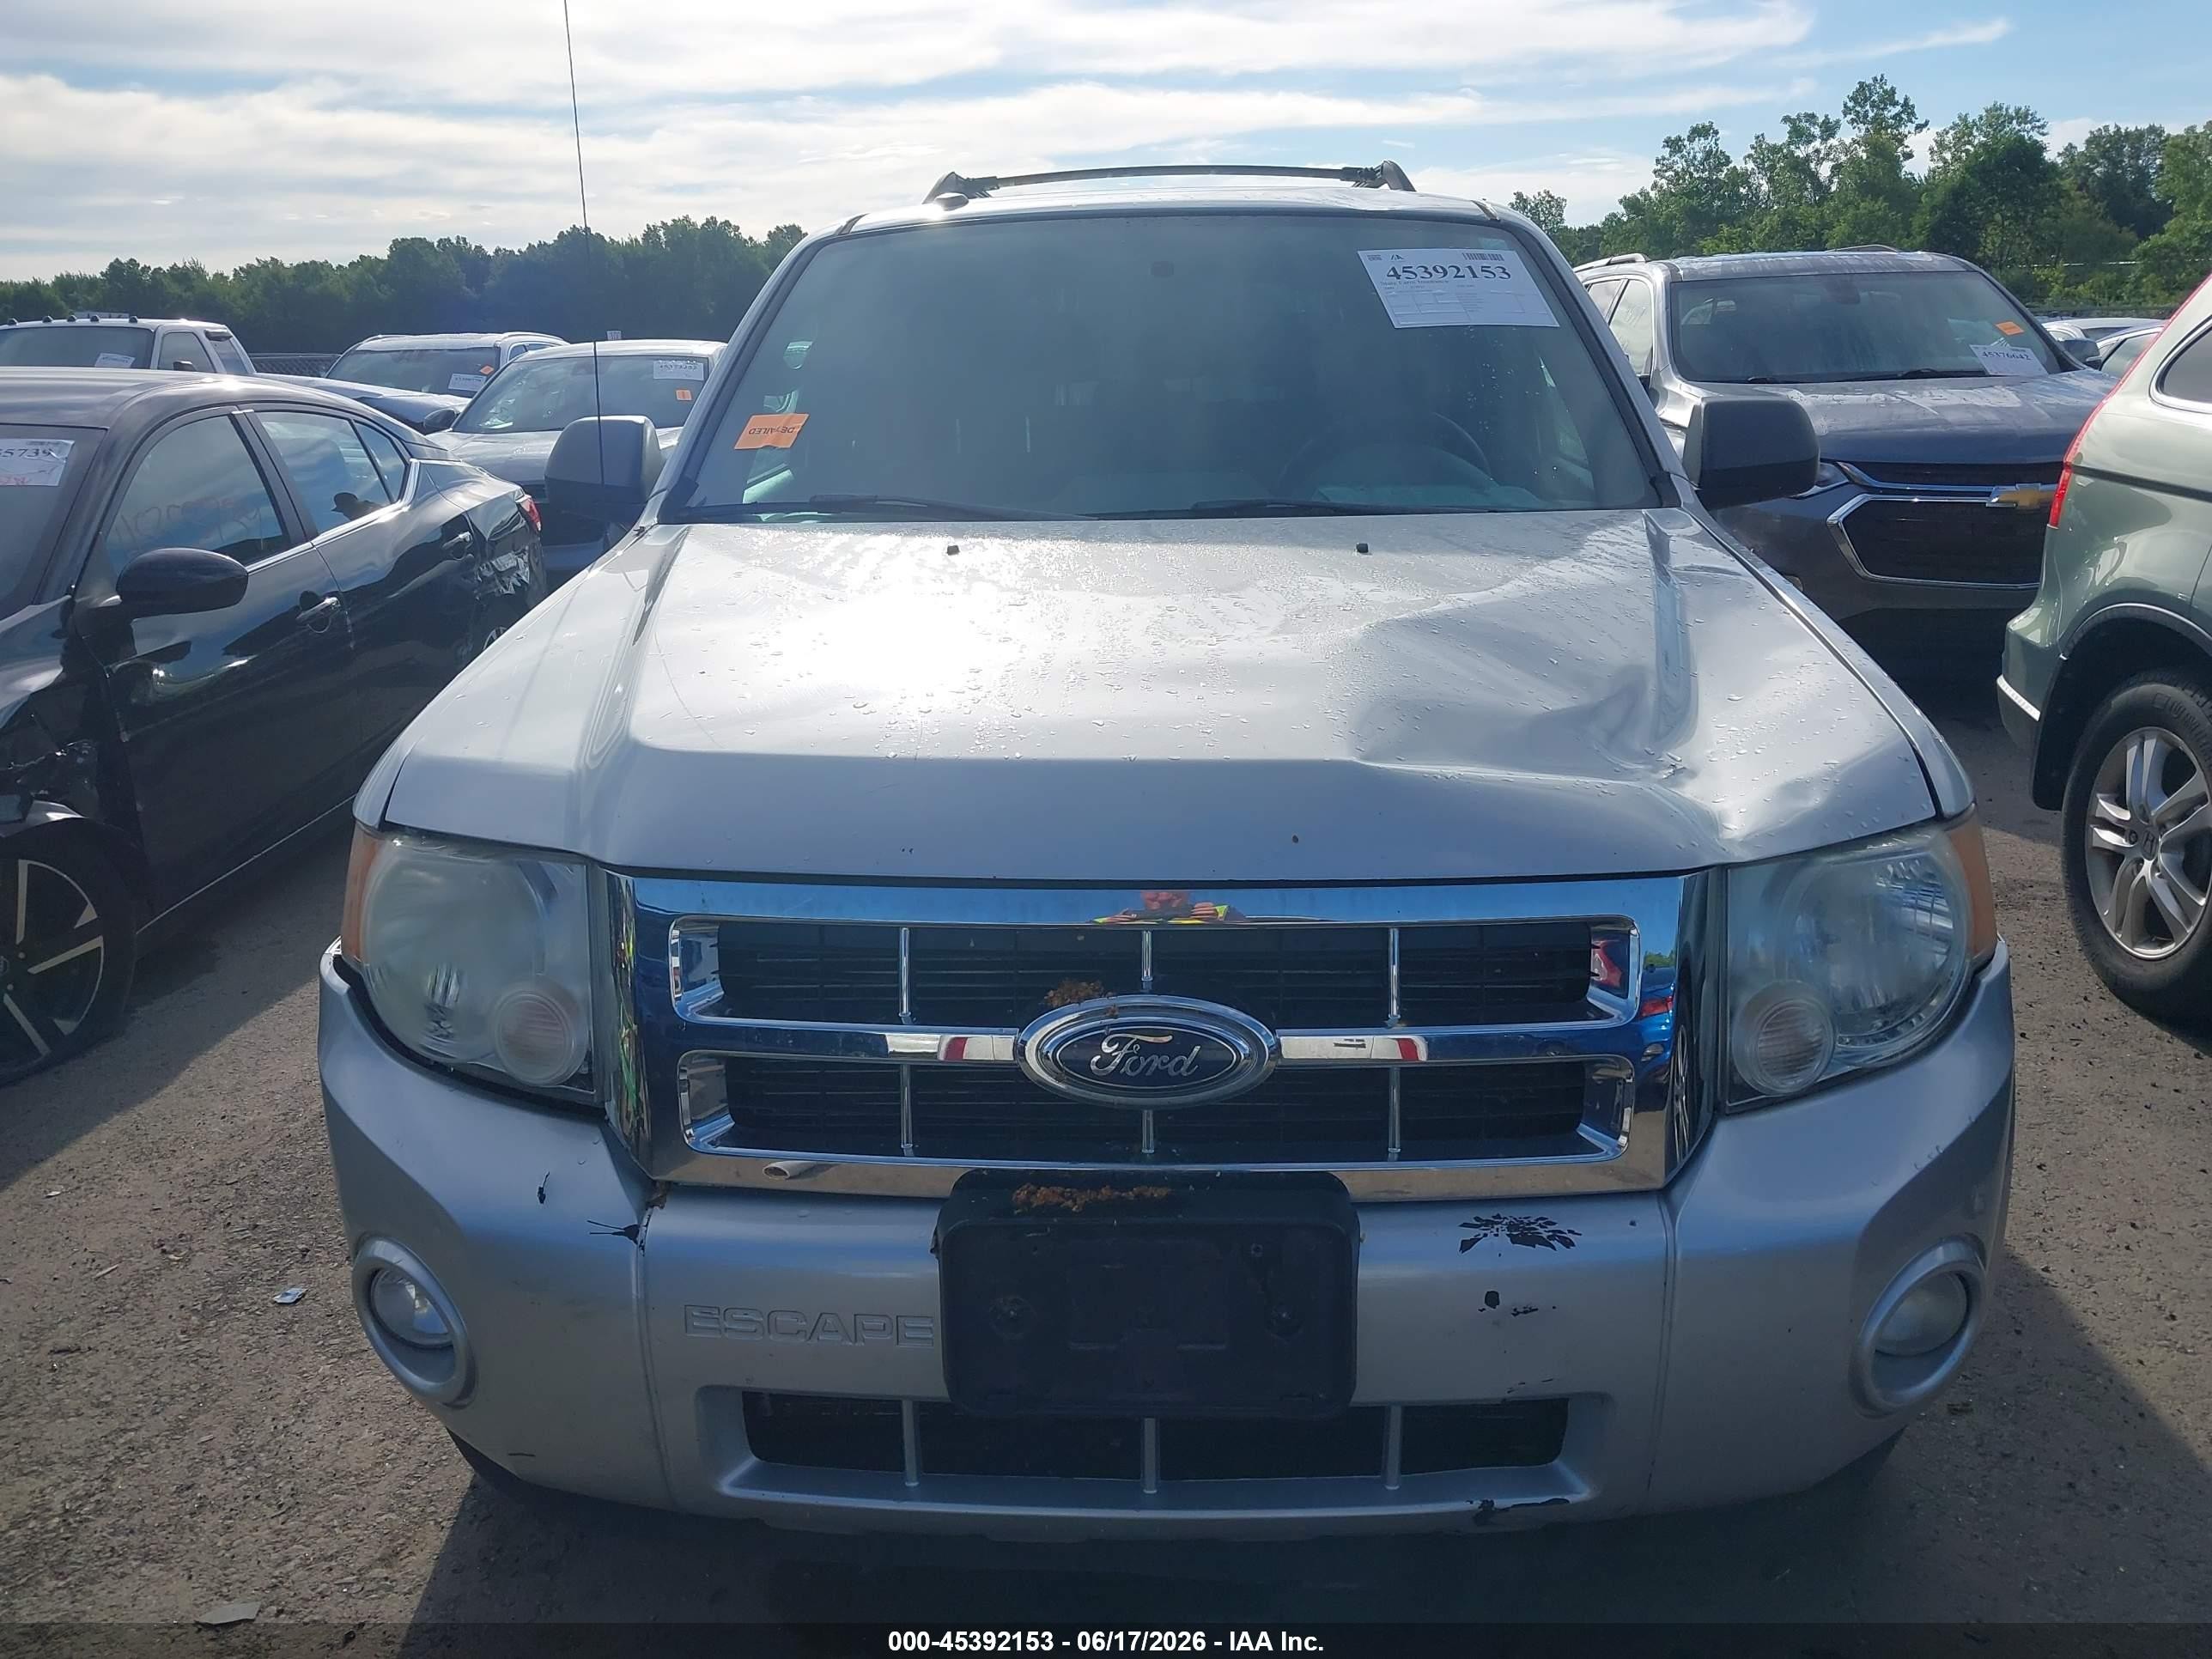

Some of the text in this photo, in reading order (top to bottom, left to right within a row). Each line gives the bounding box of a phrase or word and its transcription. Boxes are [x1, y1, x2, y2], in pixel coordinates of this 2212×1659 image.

[1386, 264, 1511, 280] 45392153
[1090, 1033, 1202, 1077] Ford
[684, 1304, 934, 1347] ESCAPE
